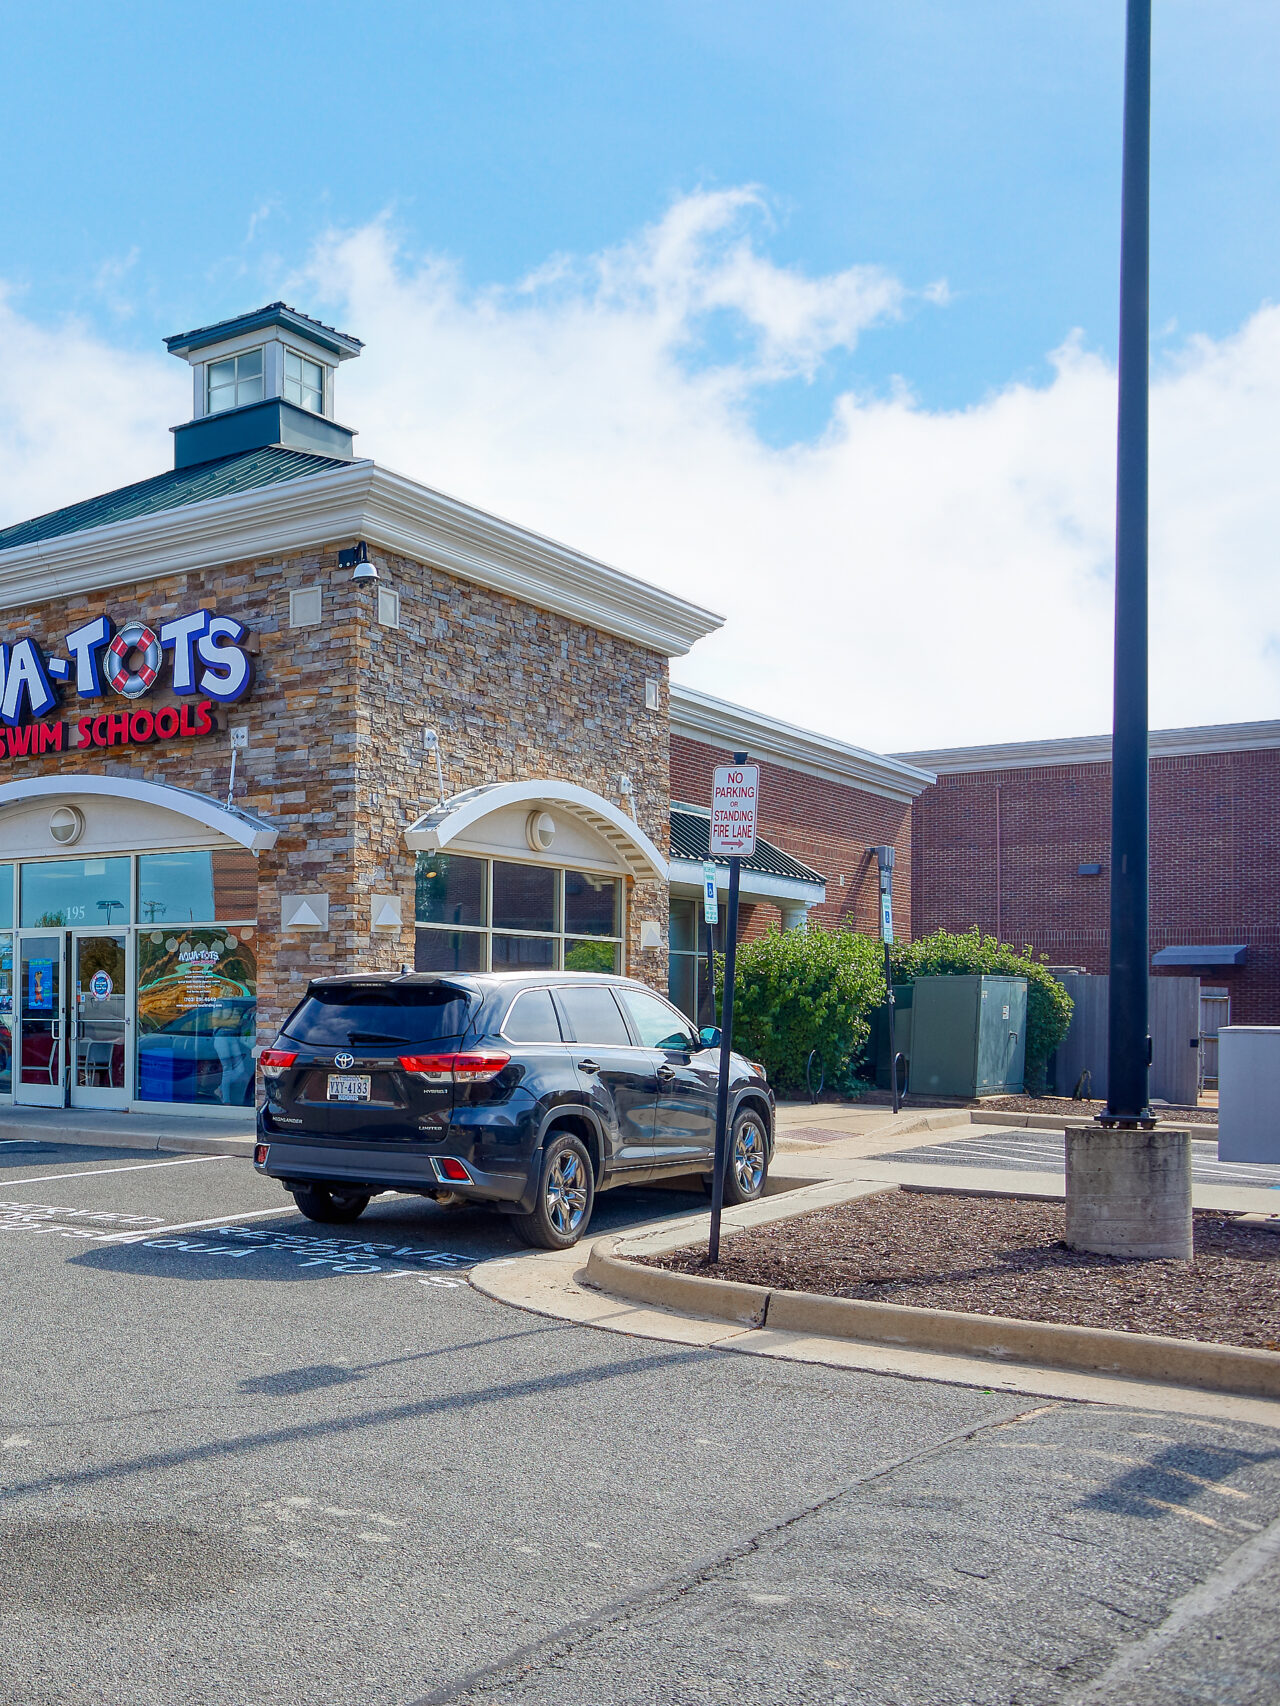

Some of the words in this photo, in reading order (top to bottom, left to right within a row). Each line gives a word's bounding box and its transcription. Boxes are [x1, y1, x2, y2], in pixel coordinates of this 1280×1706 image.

[77, 701, 214, 750] SCHOOLS
[727, 772, 744, 784] NO
[715, 786, 755, 798] PARKING
[714, 810, 754, 822] STANDING
[713, 824, 730, 838] FIRE
[732, 824, 753, 839] LANE
[66, 905, 86, 920] 195
[330, 1081, 368, 1095] VXY-4183
[201, 1226, 517, 1267] RESERVED
[248, 1243, 380, 1262] FOR
[298, 1257, 469, 1288] TOTS
